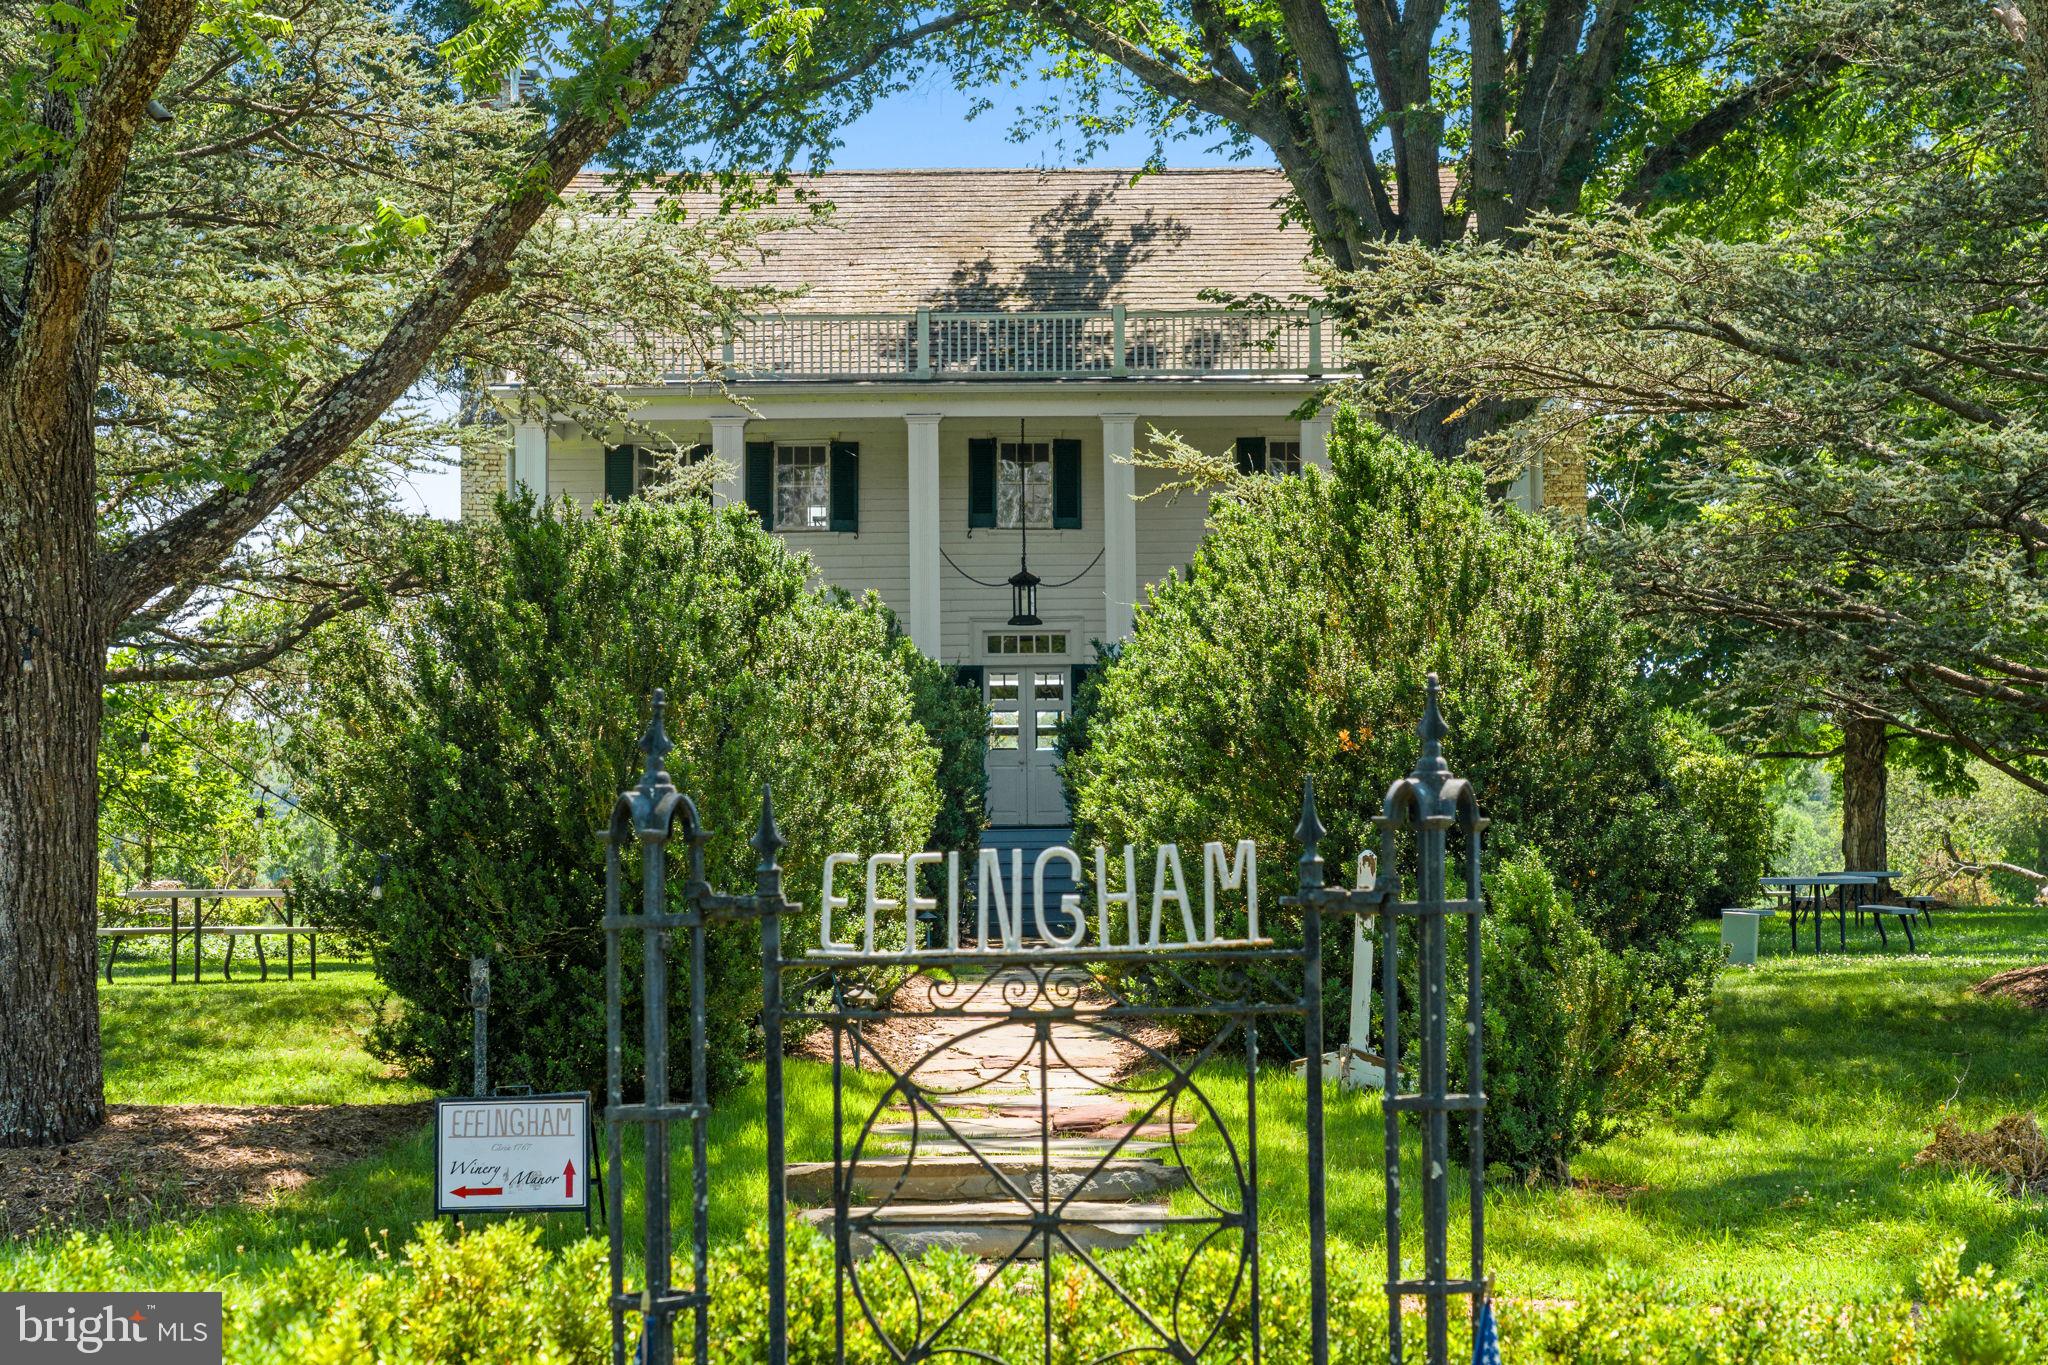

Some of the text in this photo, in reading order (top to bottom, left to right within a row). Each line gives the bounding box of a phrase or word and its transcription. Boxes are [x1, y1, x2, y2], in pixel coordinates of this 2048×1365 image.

[820, 840, 1259, 955] EFFINGHAM
[451, 1107, 573, 1137] EFFINGHAM
[450, 1159, 560, 1186] Winery Manor
